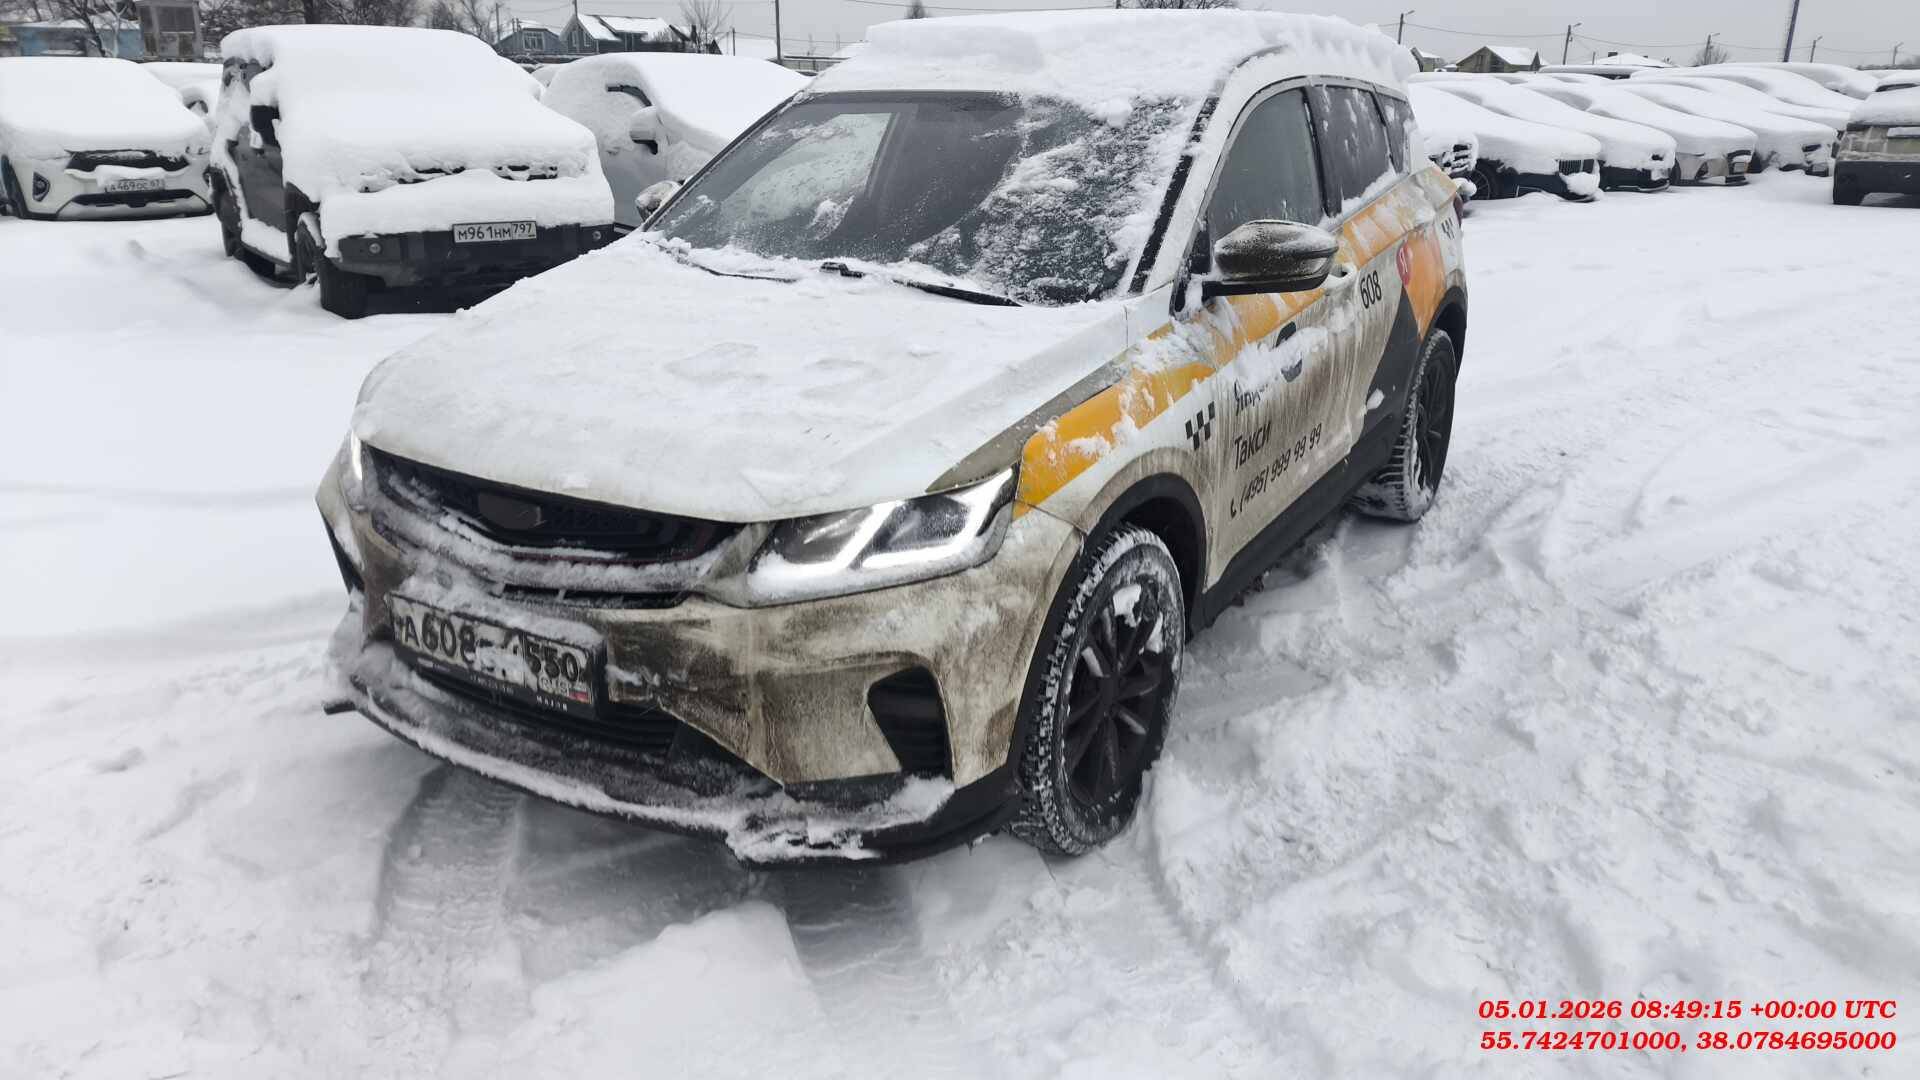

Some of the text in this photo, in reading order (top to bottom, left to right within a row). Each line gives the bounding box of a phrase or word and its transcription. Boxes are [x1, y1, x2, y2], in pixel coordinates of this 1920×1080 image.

[512, 222, 532, 234] 797
[1360, 270, 1382, 309] 608
[1234, 420, 1272, 470] Такси
[1240, 422, 1322, 512] (495) 999 99 99
